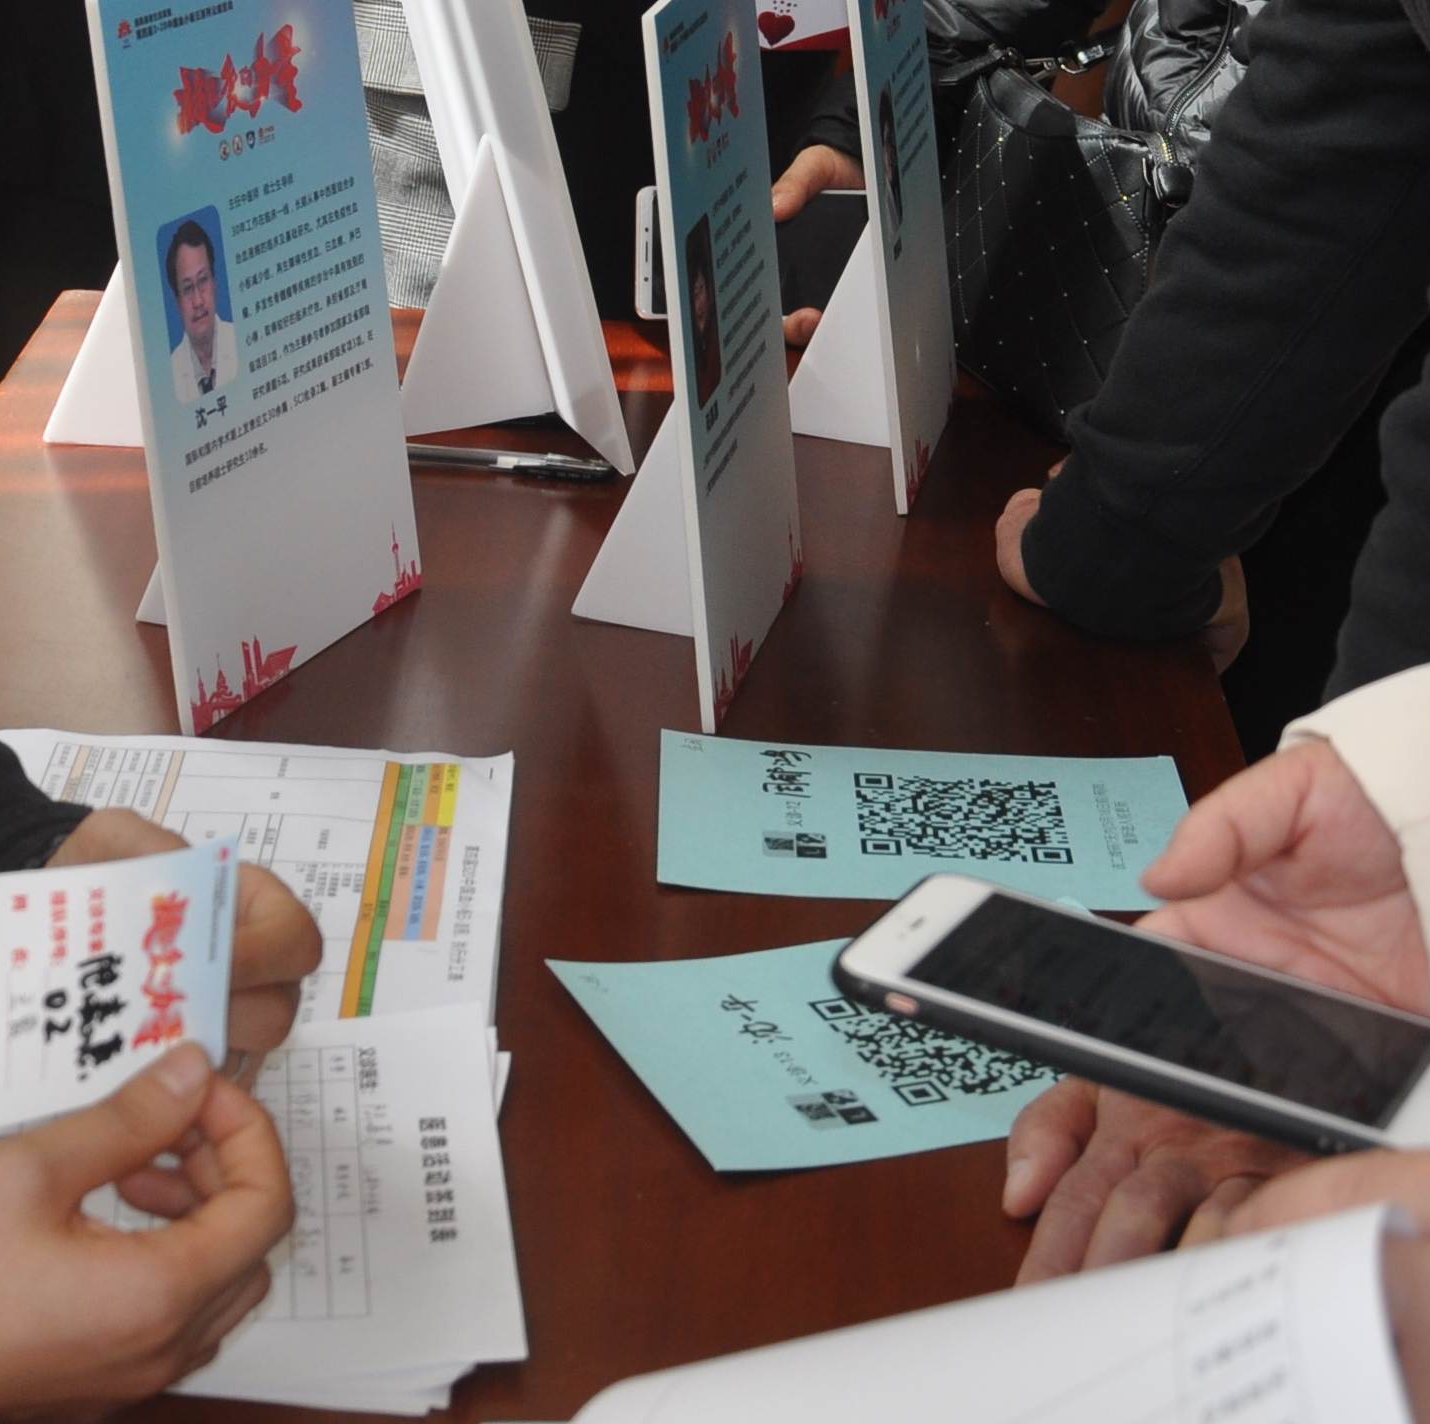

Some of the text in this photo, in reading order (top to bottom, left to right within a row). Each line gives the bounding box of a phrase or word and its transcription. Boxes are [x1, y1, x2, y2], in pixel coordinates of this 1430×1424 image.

[195, 395, 228, 429] 沈一平
[44, 989, 72, 1043] 02
